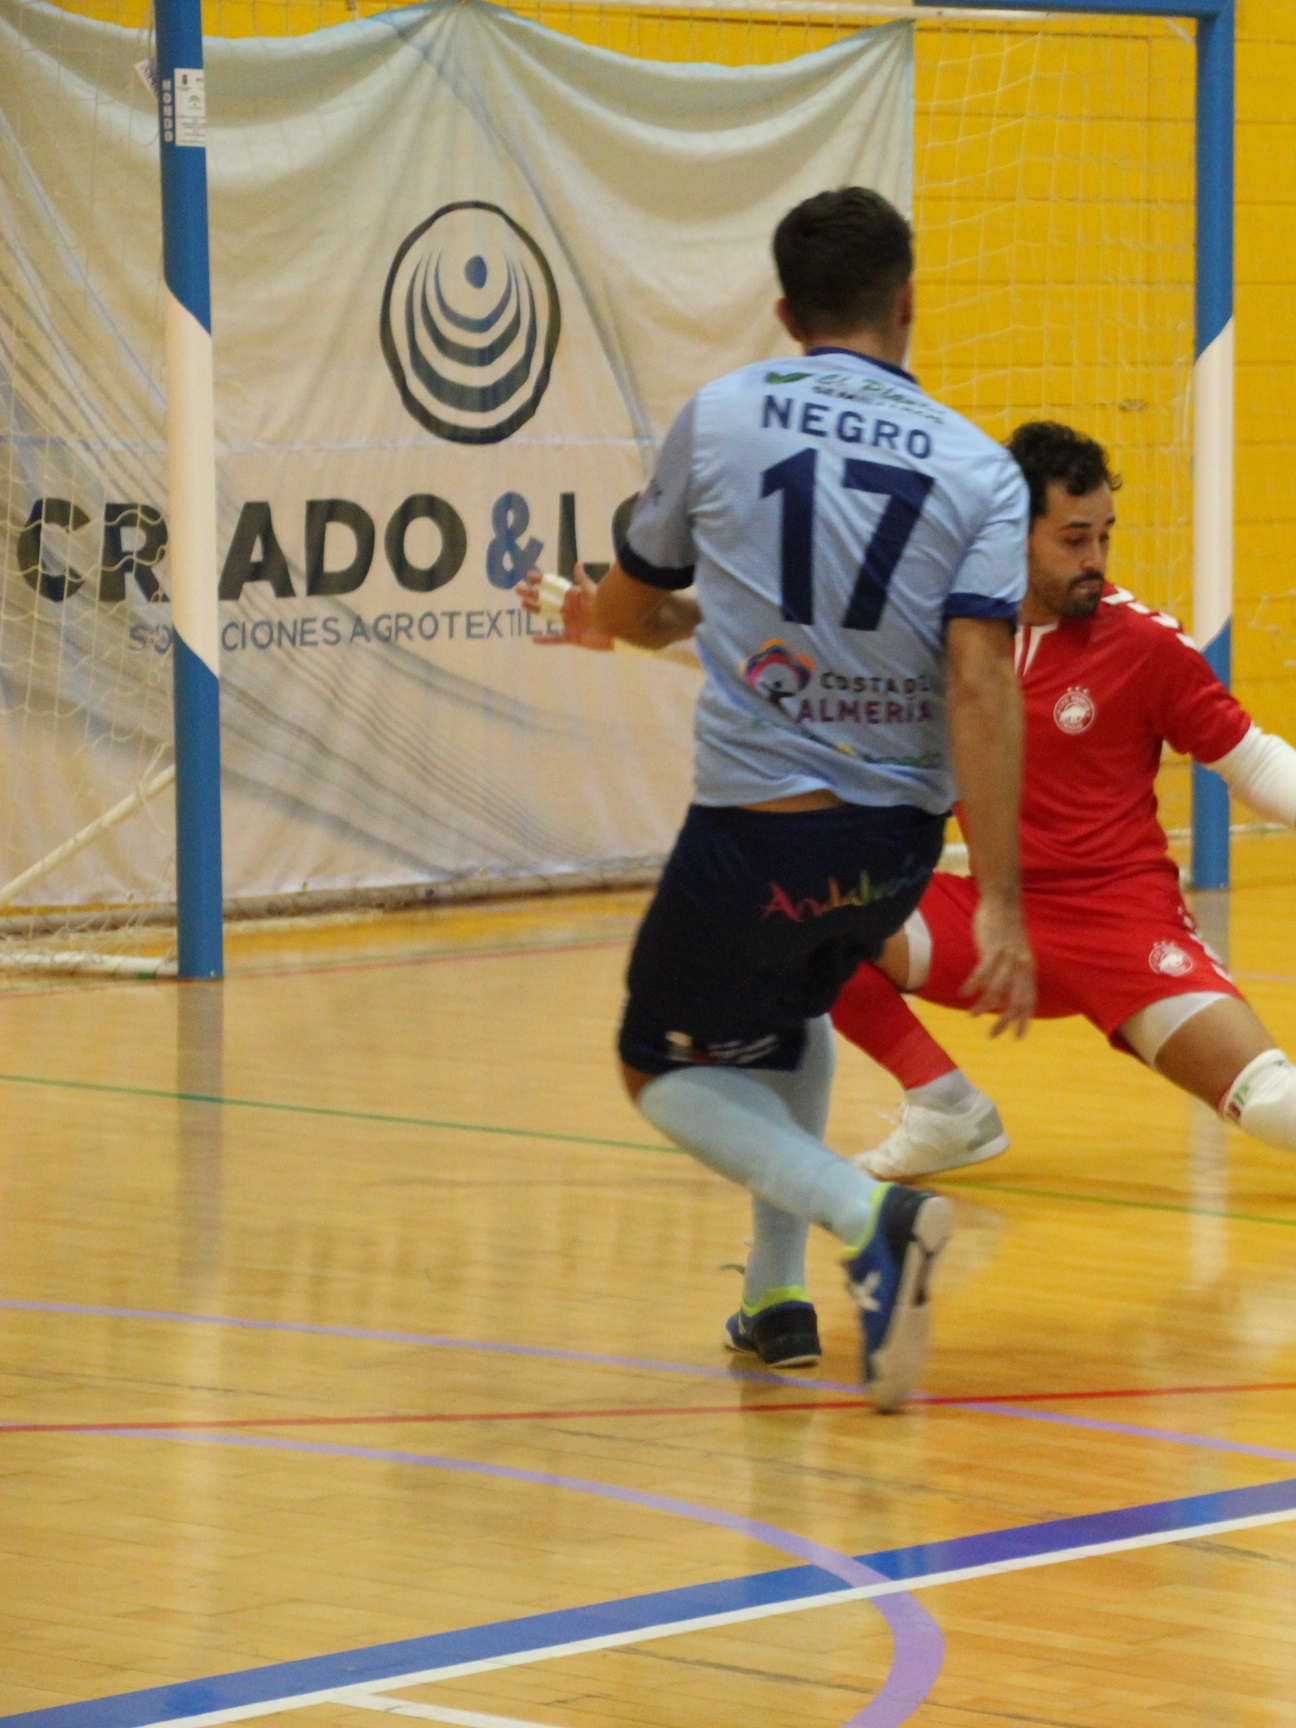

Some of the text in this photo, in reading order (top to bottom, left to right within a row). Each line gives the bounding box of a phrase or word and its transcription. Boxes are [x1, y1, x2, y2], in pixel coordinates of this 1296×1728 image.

[760, 394, 933, 460] NEGRO
[760, 447, 936, 632] 17
[128, 607, 565, 655] SOCIONES AGROTEXTILE
[820, 672, 898, 693] COSTA
